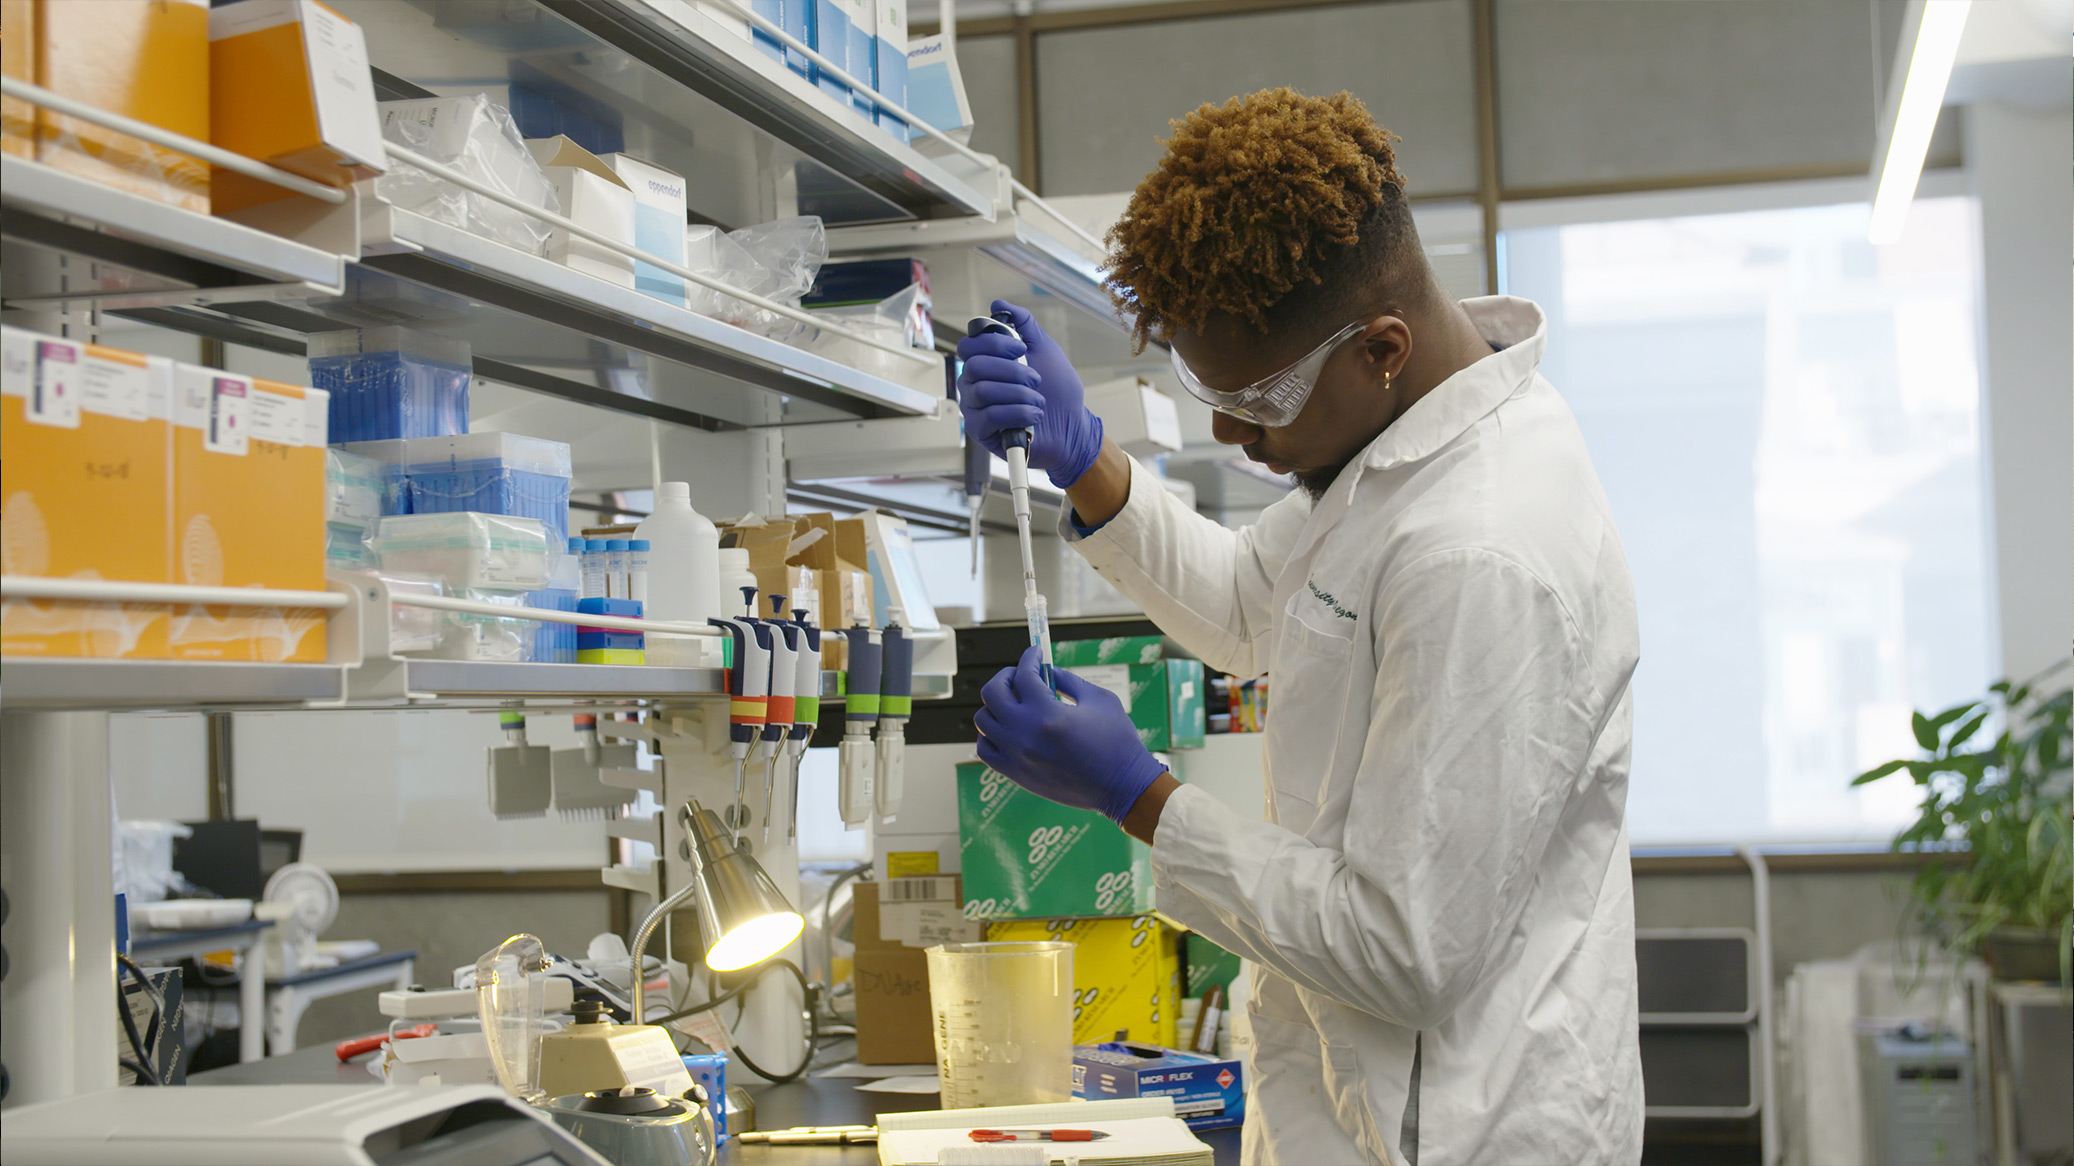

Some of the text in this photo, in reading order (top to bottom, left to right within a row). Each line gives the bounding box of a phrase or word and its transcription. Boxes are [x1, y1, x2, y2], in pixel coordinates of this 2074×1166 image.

[907, 42, 942, 58] endorf
[648, 179, 682, 199] eppendorf
[165, 1044, 181, 1084] QIAGEN
